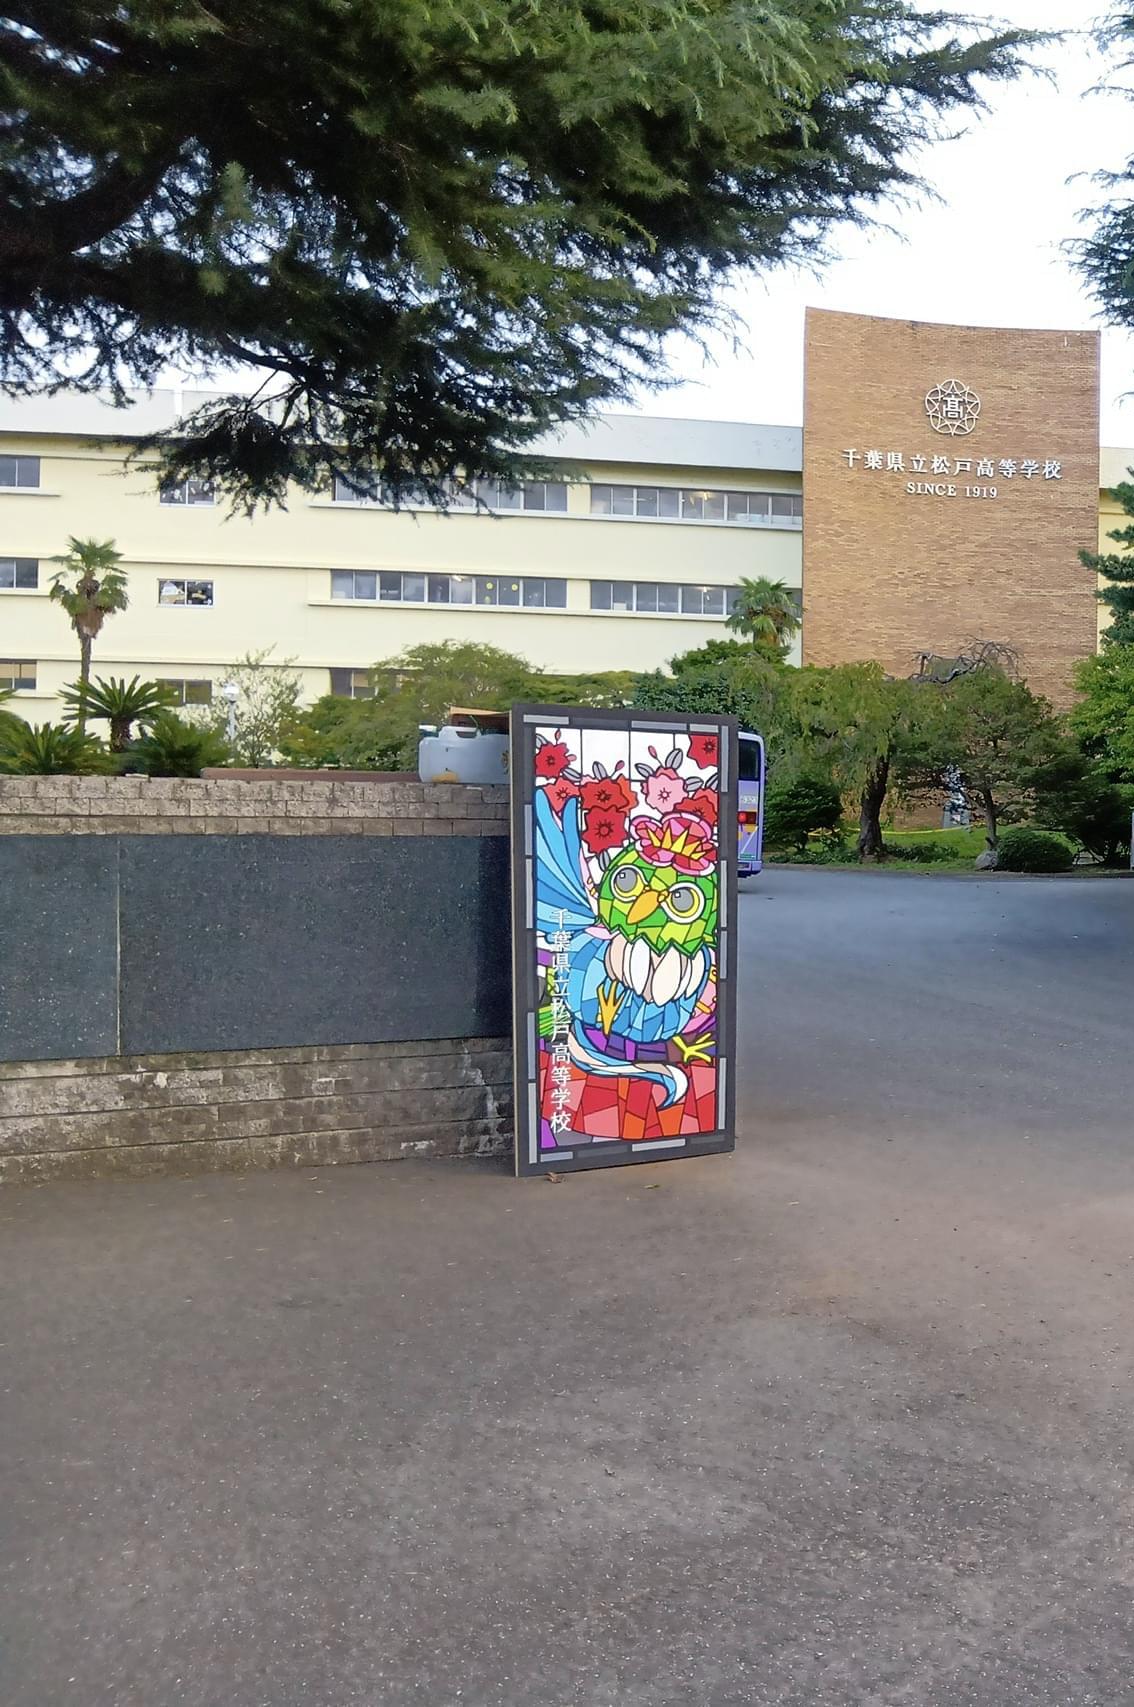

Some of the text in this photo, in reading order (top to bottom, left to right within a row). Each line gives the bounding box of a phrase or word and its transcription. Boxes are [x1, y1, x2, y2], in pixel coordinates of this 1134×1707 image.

[841, 448, 1062, 480] 千葉県立松戸高等学校
[906, 481, 998, 499] SINCE 1919
[550, 908, 572, 1132] 千葉県立松戸高等学校
